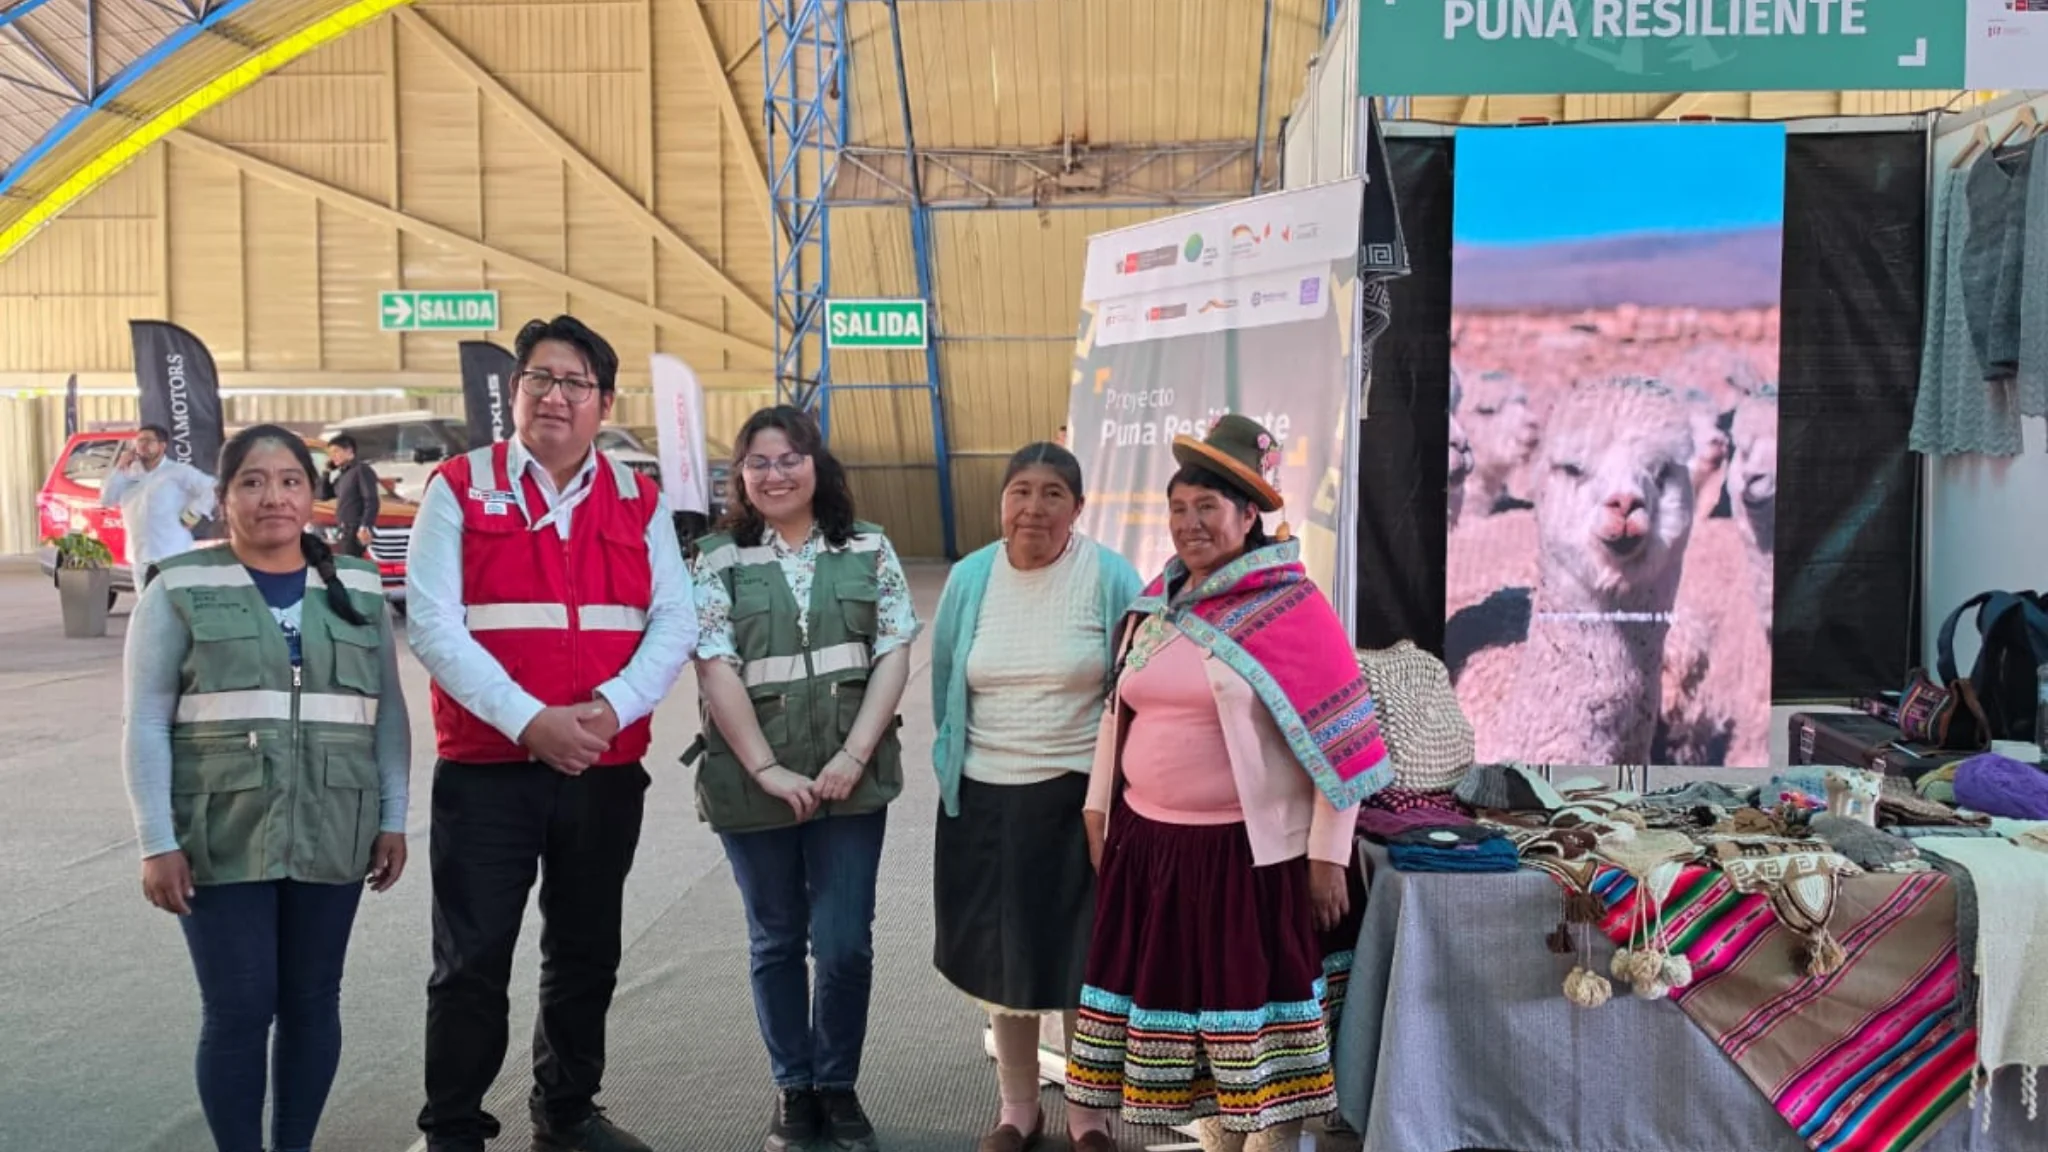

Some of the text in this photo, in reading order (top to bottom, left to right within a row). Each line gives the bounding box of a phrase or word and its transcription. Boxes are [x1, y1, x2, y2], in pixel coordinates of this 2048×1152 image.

[1444, 0, 1867, 39] PUNA RESILIENTE
[419, 299, 493, 321] SALIDA
[832, 311, 921, 336] SALIDA
[1105, 387, 1174, 413] Proyecto
[1100, 418, 1157, 448] Puna
